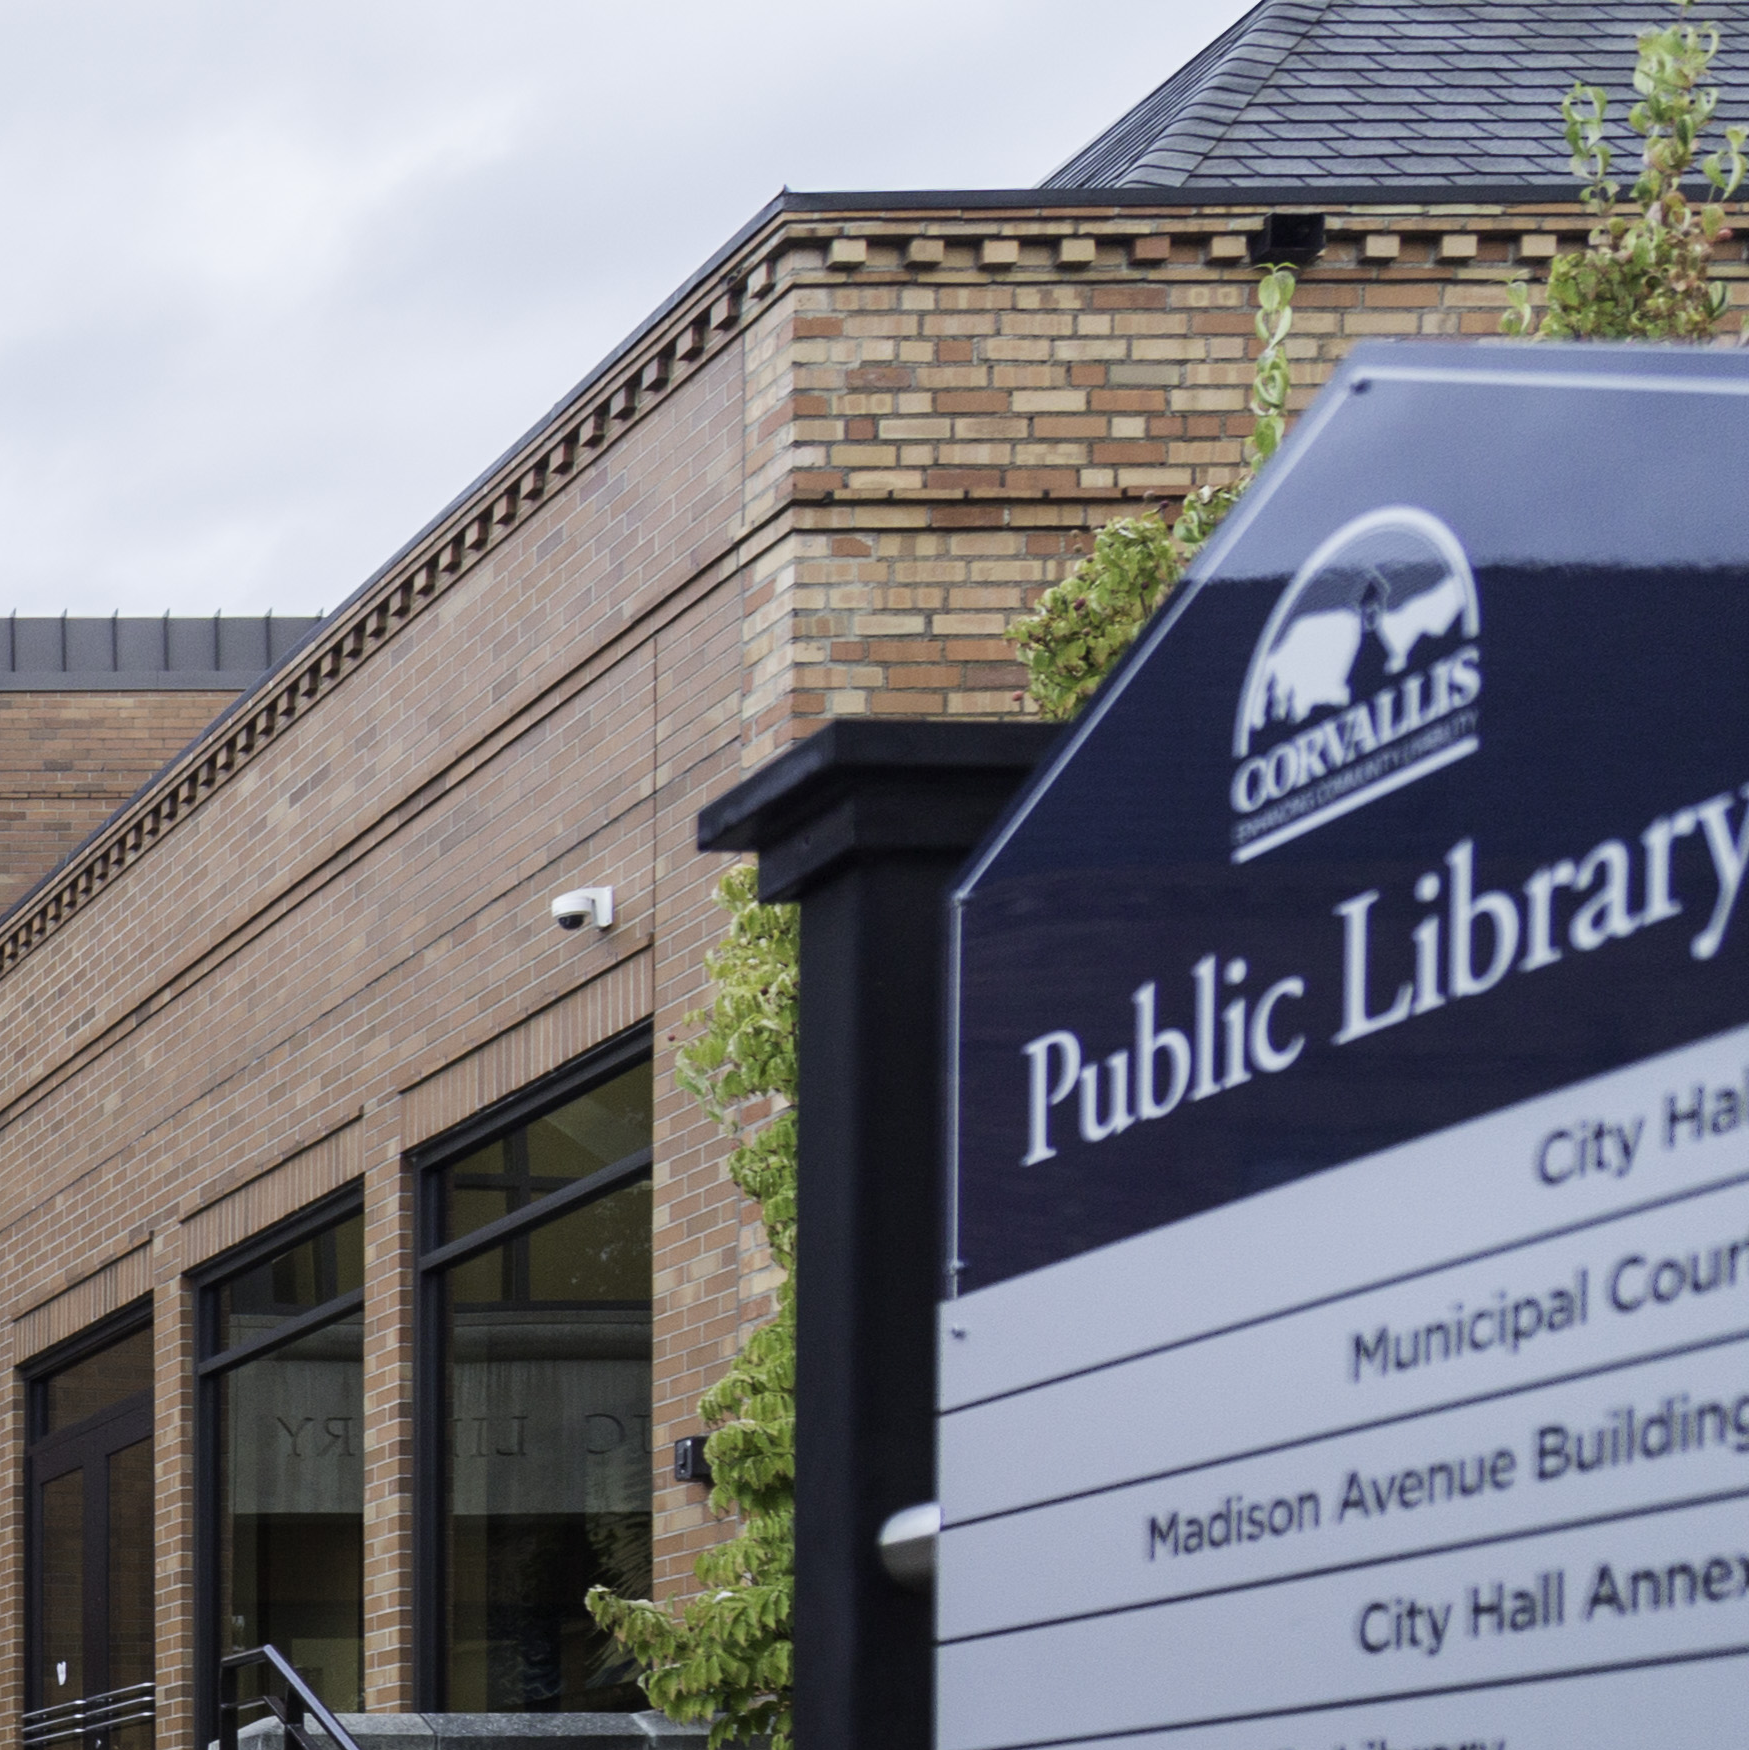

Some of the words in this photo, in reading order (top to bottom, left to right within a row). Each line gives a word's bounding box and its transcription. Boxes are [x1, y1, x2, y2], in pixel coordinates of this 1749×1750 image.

[1231, 644, 1482, 813] CORVALLIS
[1019, 953, 1307, 1167] Public
[1331, 780, 1749, 1047] Library
[1536, 1114, 1646, 1187] City
[1351, 1266, 1590, 1385] Municipal
[1149, 1490, 1321, 1561] Madison
[1335, 1447, 1517, 1525] Avenue
[1357, 1596, 1453, 1656] City
[1469, 1568, 1565, 1637] Hall
